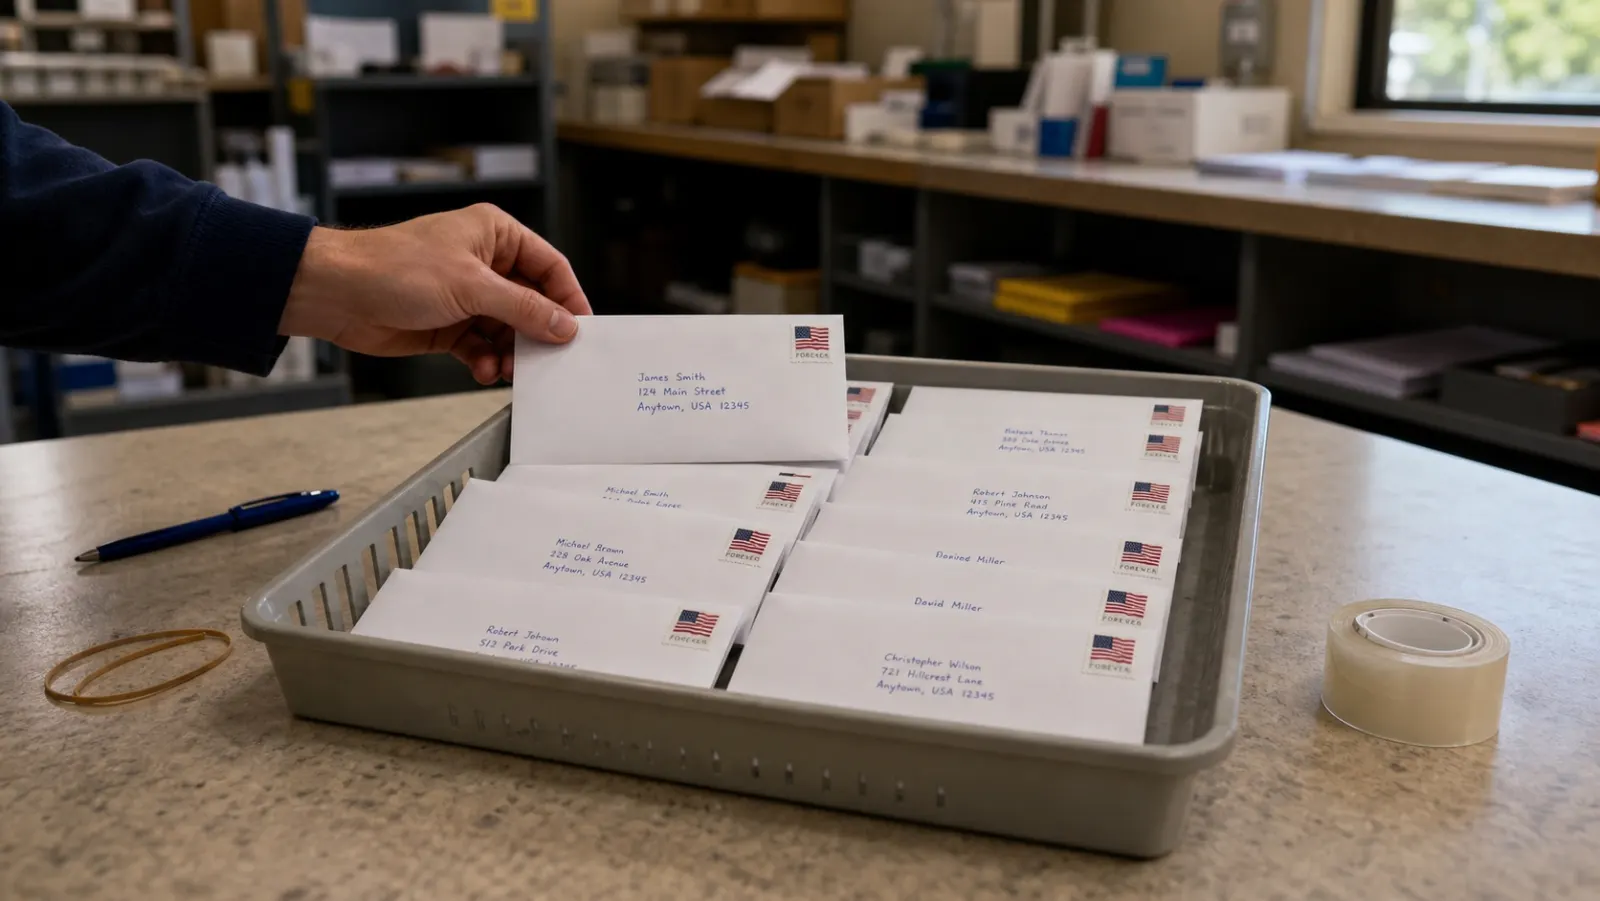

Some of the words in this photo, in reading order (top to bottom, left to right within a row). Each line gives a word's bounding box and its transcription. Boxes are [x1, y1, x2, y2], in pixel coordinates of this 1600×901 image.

[638, 372, 669, 382] James
[676, 372, 706, 381] Smith
[638, 388, 657, 396] 124
[663, 388, 688, 396] Main
[694, 386, 726, 396] Street
[637, 402, 684, 415] Anytown,
[691, 401, 712, 410] USA
[720, 401, 750, 410] 12345
[973, 488, 1005, 497] Robert
[1012, 491, 1051, 500] Johnson
[1014, 511, 1033, 519] USA
[1040, 512, 1069, 521] 12345
[556, 538, 591, 550] Michael
[594, 543, 624, 555] Brown
[574, 553, 592, 563] Oak
[597, 556, 629, 569] Avenue
[976, 555, 1006, 565] Miller
[542, 561, 586, 577] Anytown,
[592, 568, 612, 578] USA
[618, 573, 648, 584] 12345
[914, 596, 945, 608] David
[951, 600, 983, 612] Miller
[486, 625, 519, 637] Robert
[502, 640, 525, 652] Park
[531, 645, 559, 657] Drive
[884, 652, 943, 668] Christopher
[949, 659, 982, 671] Wilson
[881, 666, 900, 676] 721
[907, 669, 952, 681] Hillcrest
[957, 675, 983, 686] Lane
[876, 679, 925, 695] Anytown,
[931, 686, 954, 696] USA
[962, 689, 995, 701] 12345
